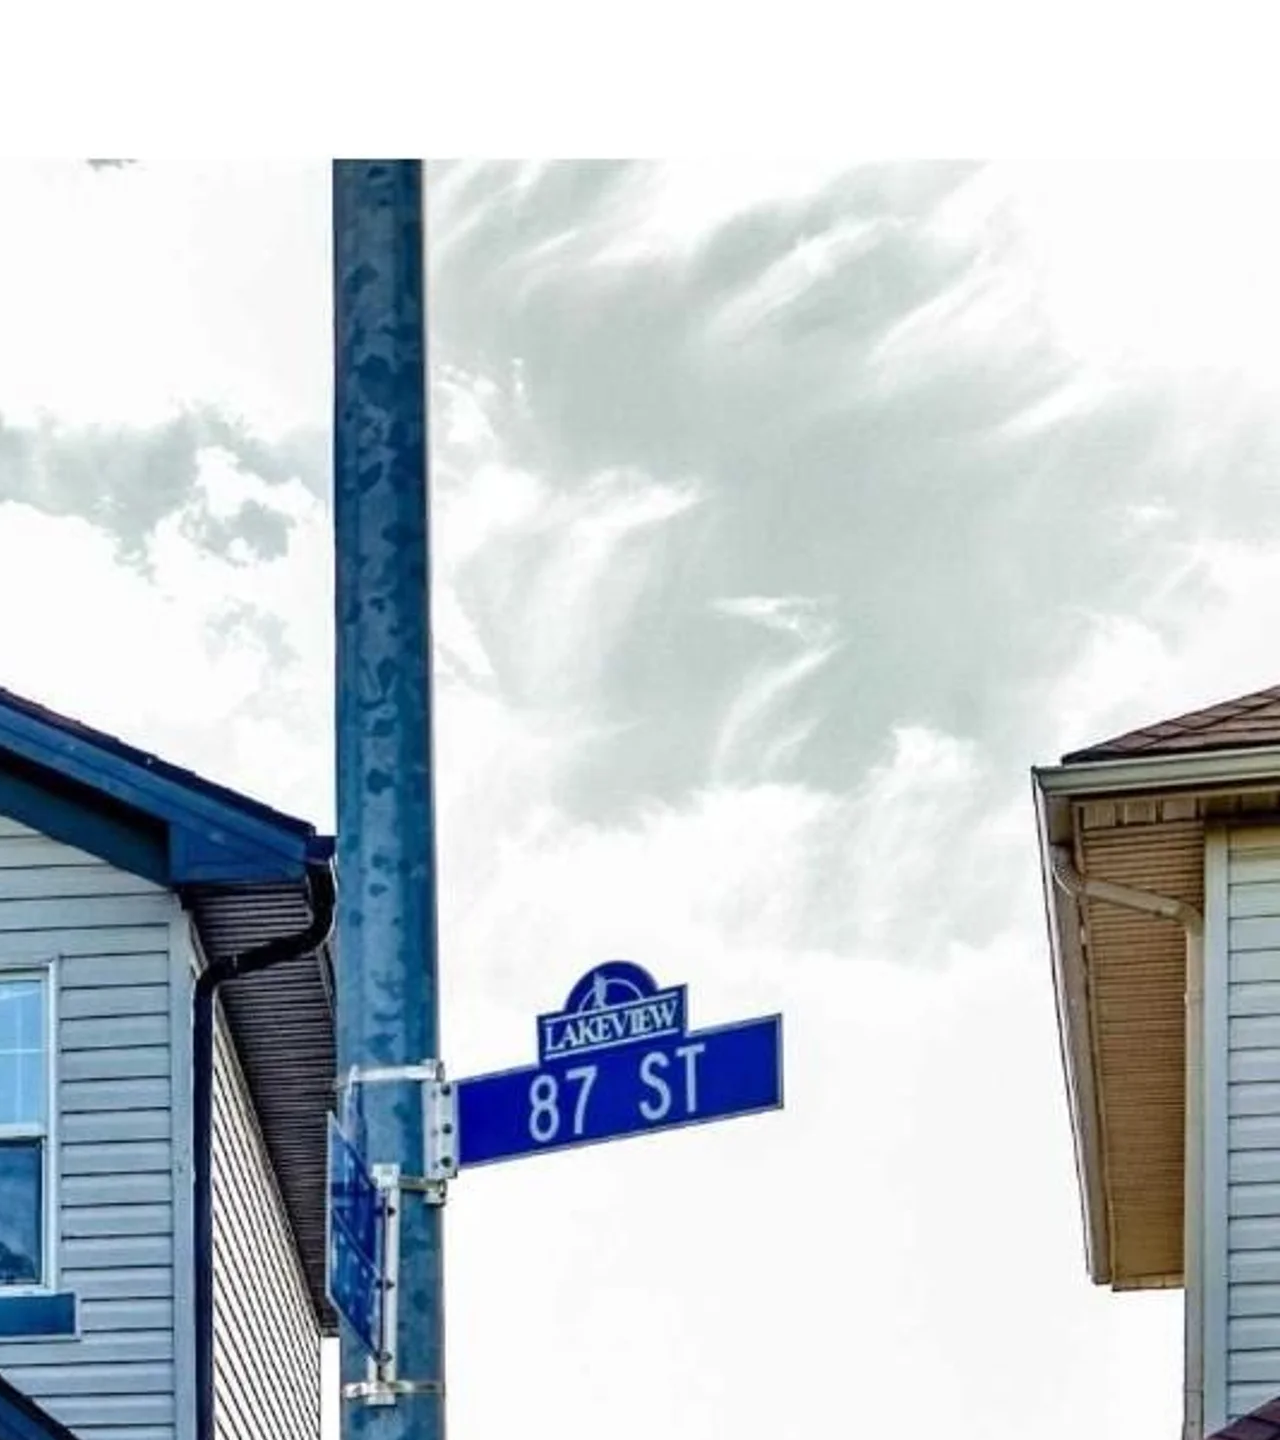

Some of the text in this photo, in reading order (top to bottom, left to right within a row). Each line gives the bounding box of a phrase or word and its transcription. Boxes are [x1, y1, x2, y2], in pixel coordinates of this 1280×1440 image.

[544, 999, 678, 1053] LAKEVIEW
[529, 1043, 706, 1142] 87 ST
